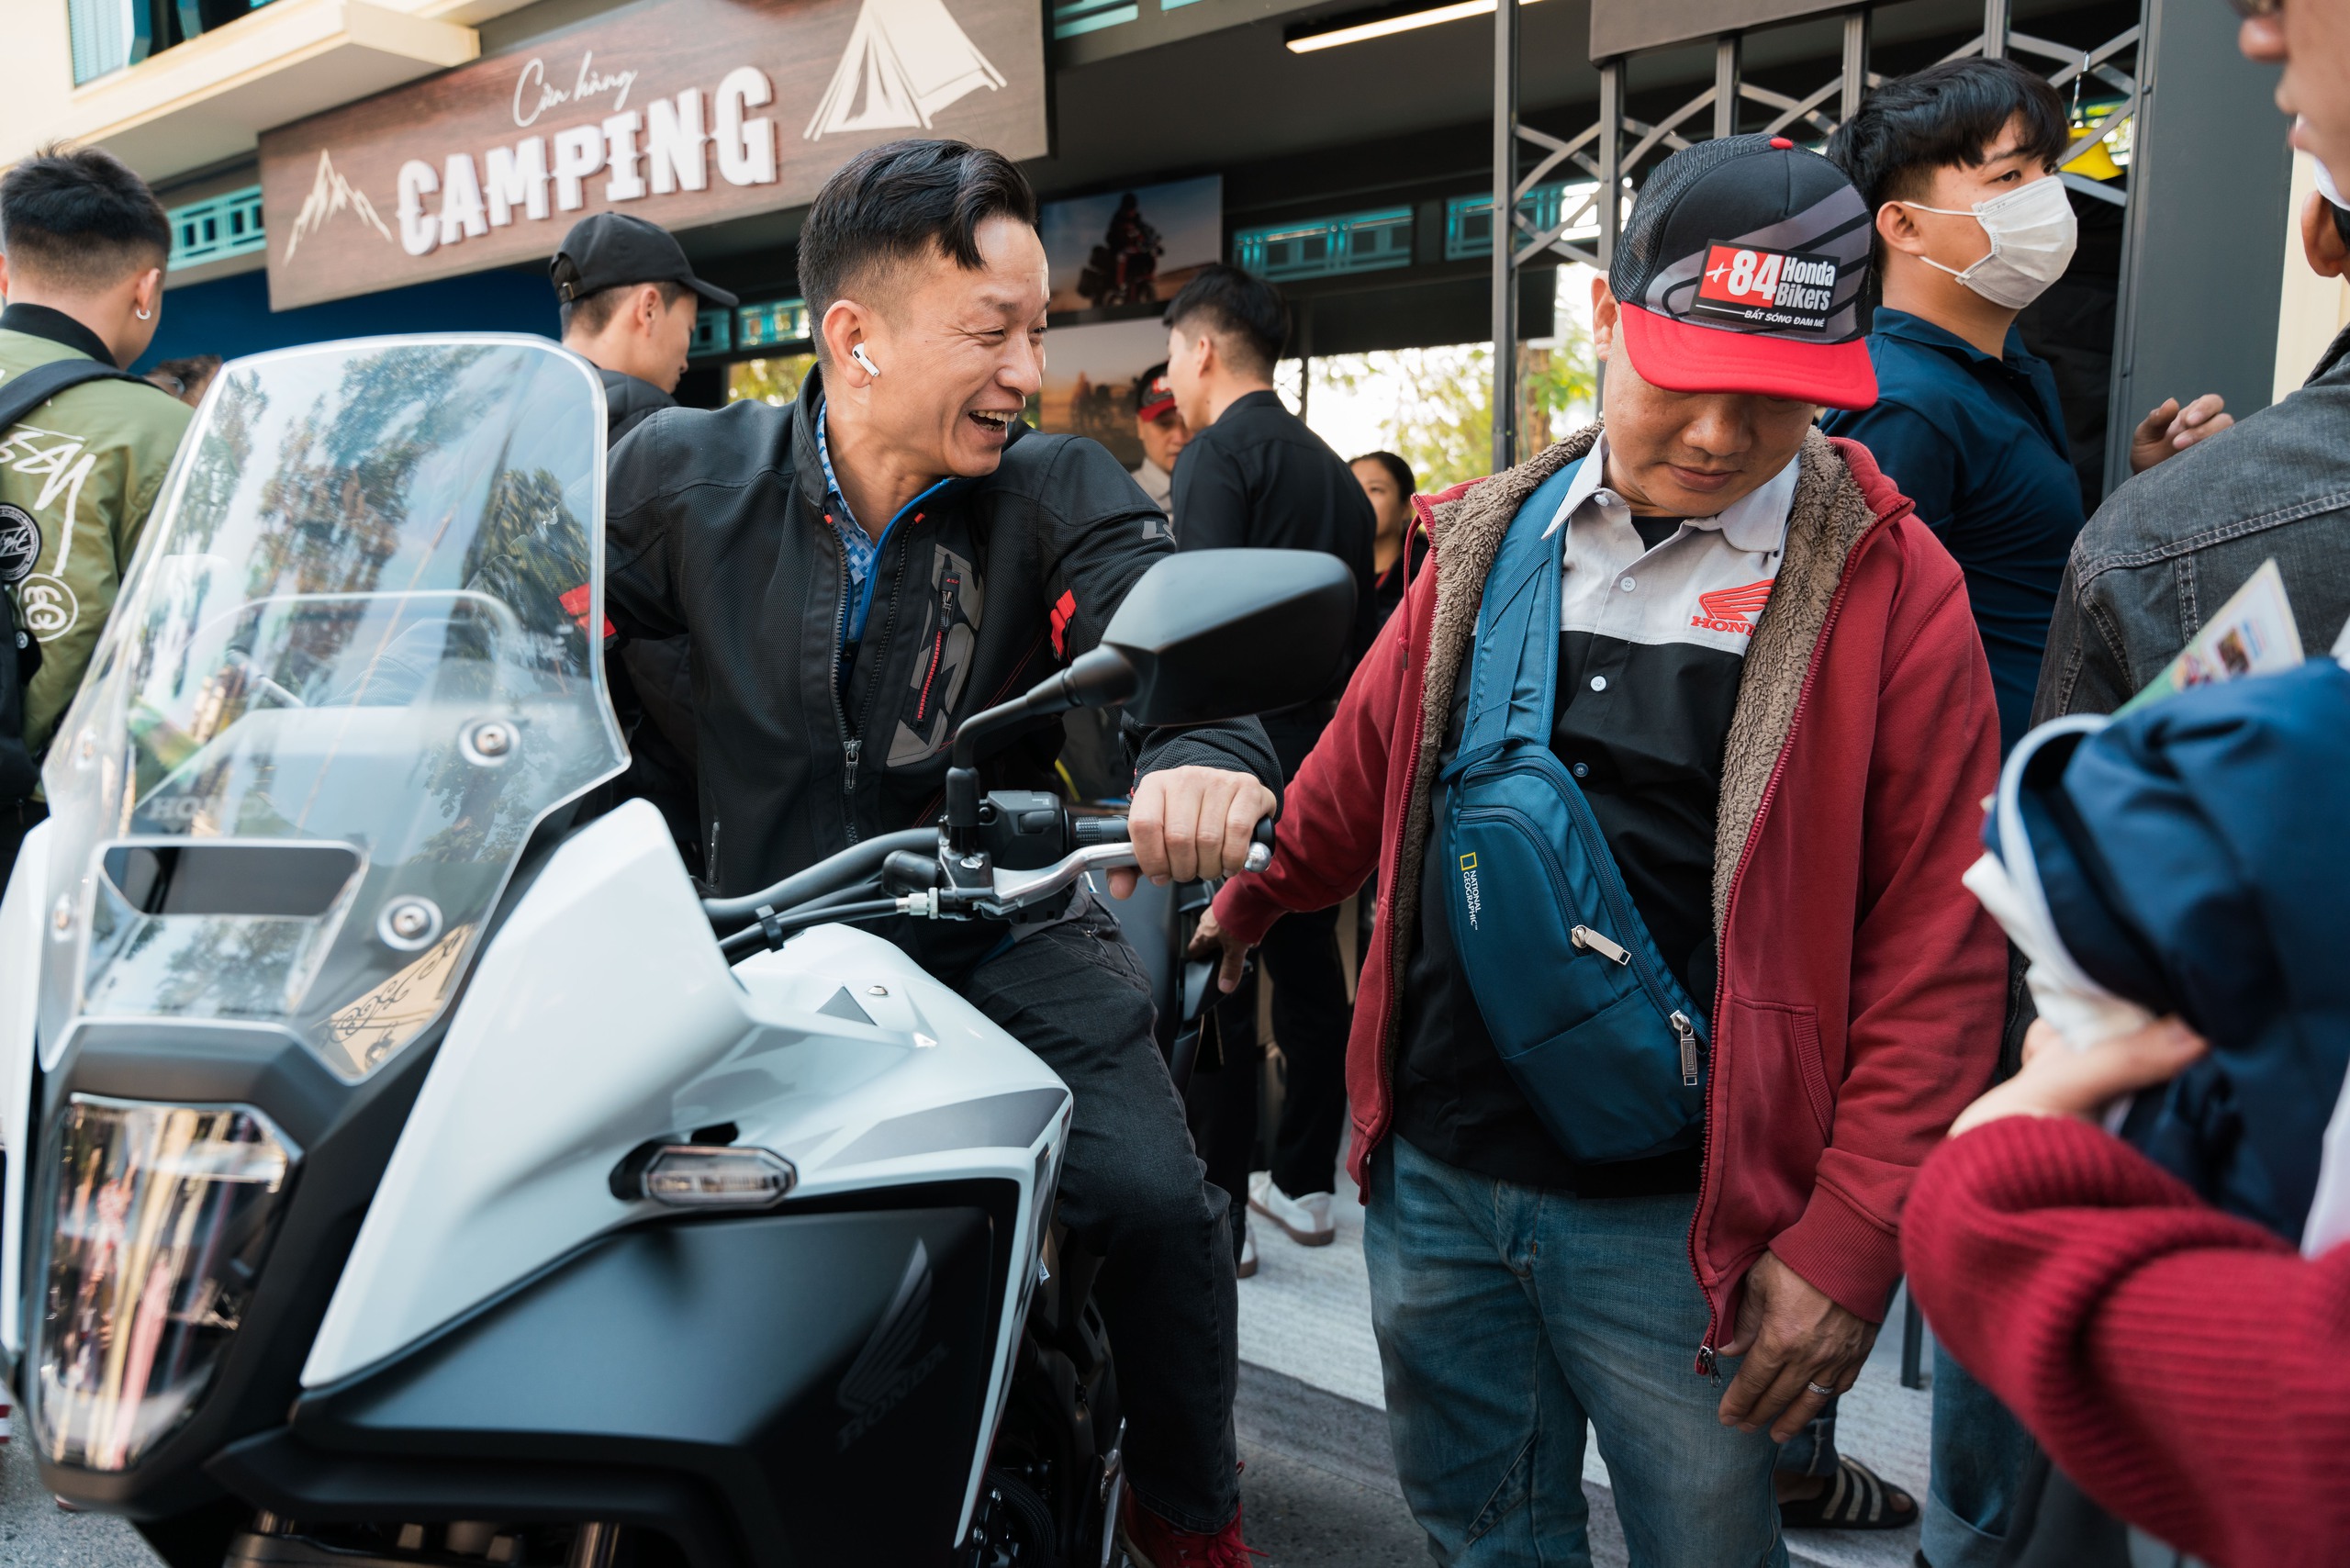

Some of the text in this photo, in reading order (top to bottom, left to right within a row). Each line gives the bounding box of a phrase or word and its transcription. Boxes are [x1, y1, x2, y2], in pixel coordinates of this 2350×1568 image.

[573, 50, 639, 112] hàng
[397, 65, 778, 256] CAMPING
[1781, 256, 1836, 287] Honda
[1774, 282, 1831, 311] Bikers
[1764, 312, 1793, 324] SÓNG
[1690, 615, 1756, 638] HON
[1471, 870, 1481, 913] NATIONAL
[837, 1341, 951, 1454] HONDA
